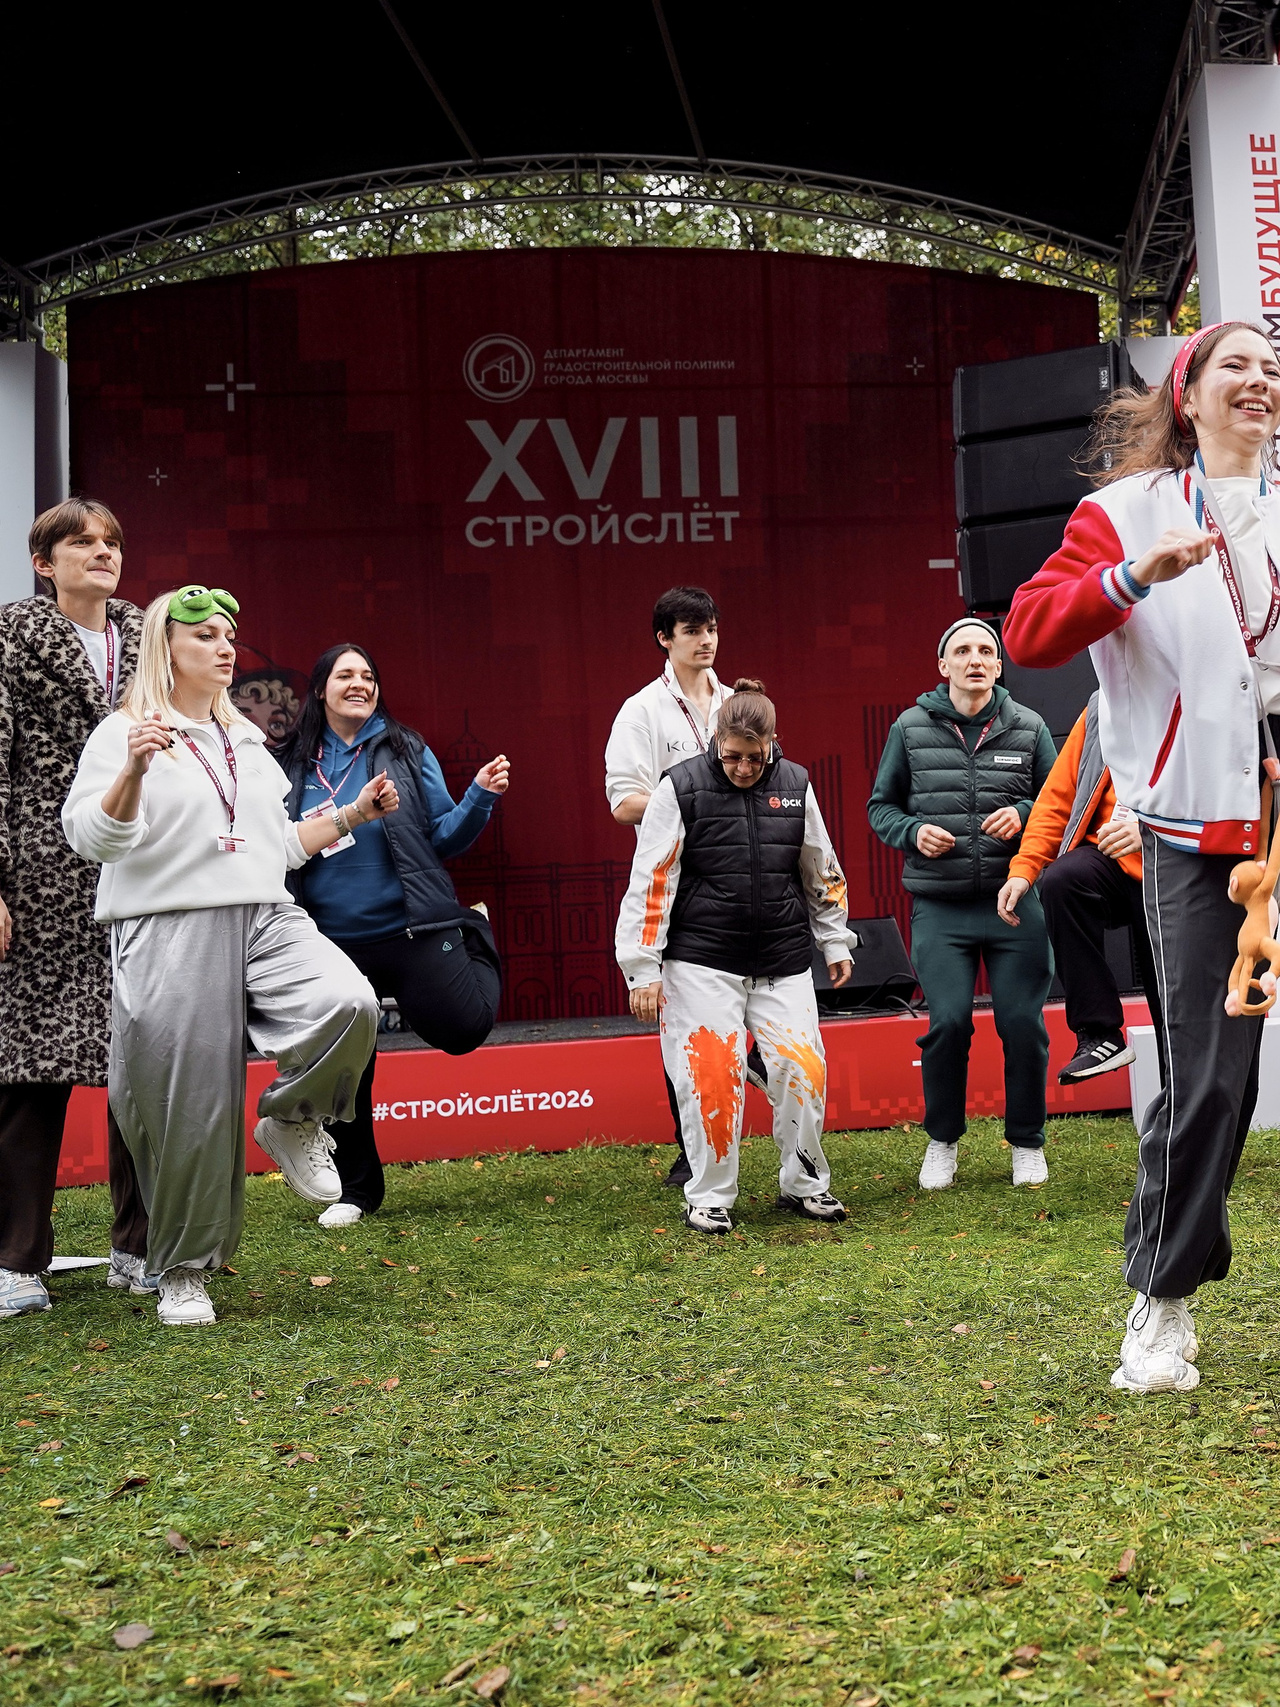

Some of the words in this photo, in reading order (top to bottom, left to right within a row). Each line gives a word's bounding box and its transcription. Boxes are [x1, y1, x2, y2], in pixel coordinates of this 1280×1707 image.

[543, 348, 625, 360] ДЕПАРТАМЕНТ
[543, 359, 671, 372] ГРАДОСТРОИТЕЛЬНОЙ
[674, 360, 735, 370] ПОЛИТИКИ
[543, 373, 593, 385] ГОРОДА
[596, 373, 649, 384] МОСКВЫ
[465, 415, 740, 502] XVIII
[465, 503, 740, 548] СТРОЙСЛЁТ
[1219, 549, 1232, 578] ГОРОДА
[781, 797, 802, 809] ФСК
[372, 1089, 594, 1121] #СТРОЙСЛЁТ2026
